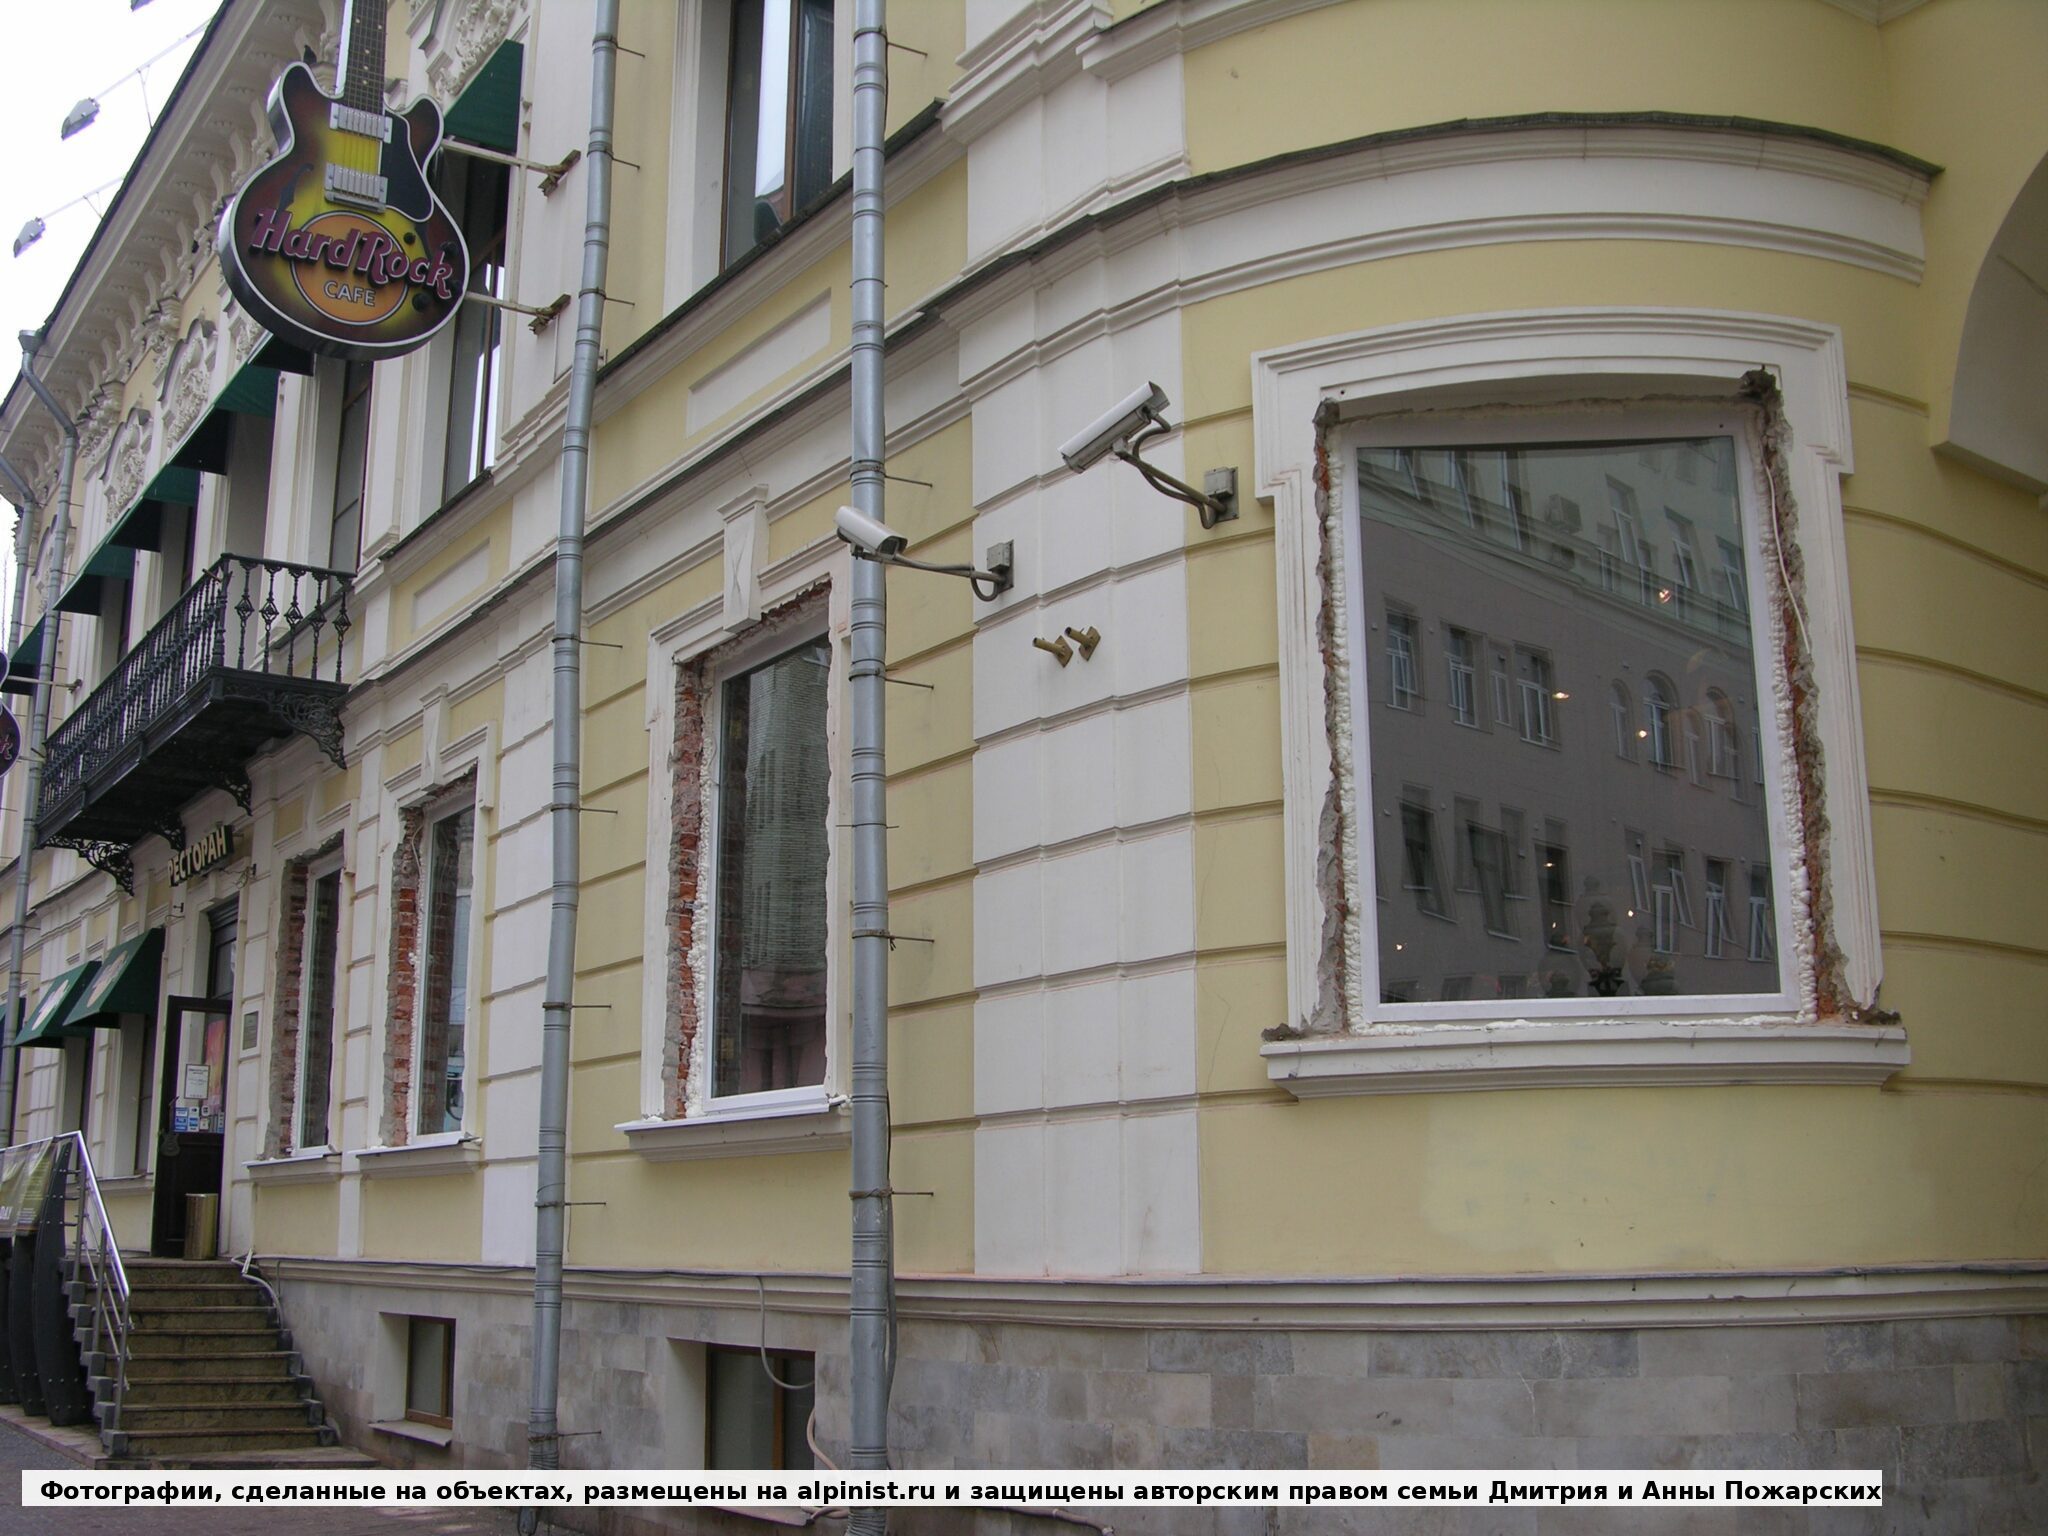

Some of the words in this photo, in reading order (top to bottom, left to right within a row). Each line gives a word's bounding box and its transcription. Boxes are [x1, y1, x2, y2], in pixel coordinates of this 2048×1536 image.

[250, 208, 361, 268] Hard
[356, 231, 454, 299] Rock
[323, 280, 377, 307] CAFE
[167, 825, 227, 887] РЕСТОРАН
